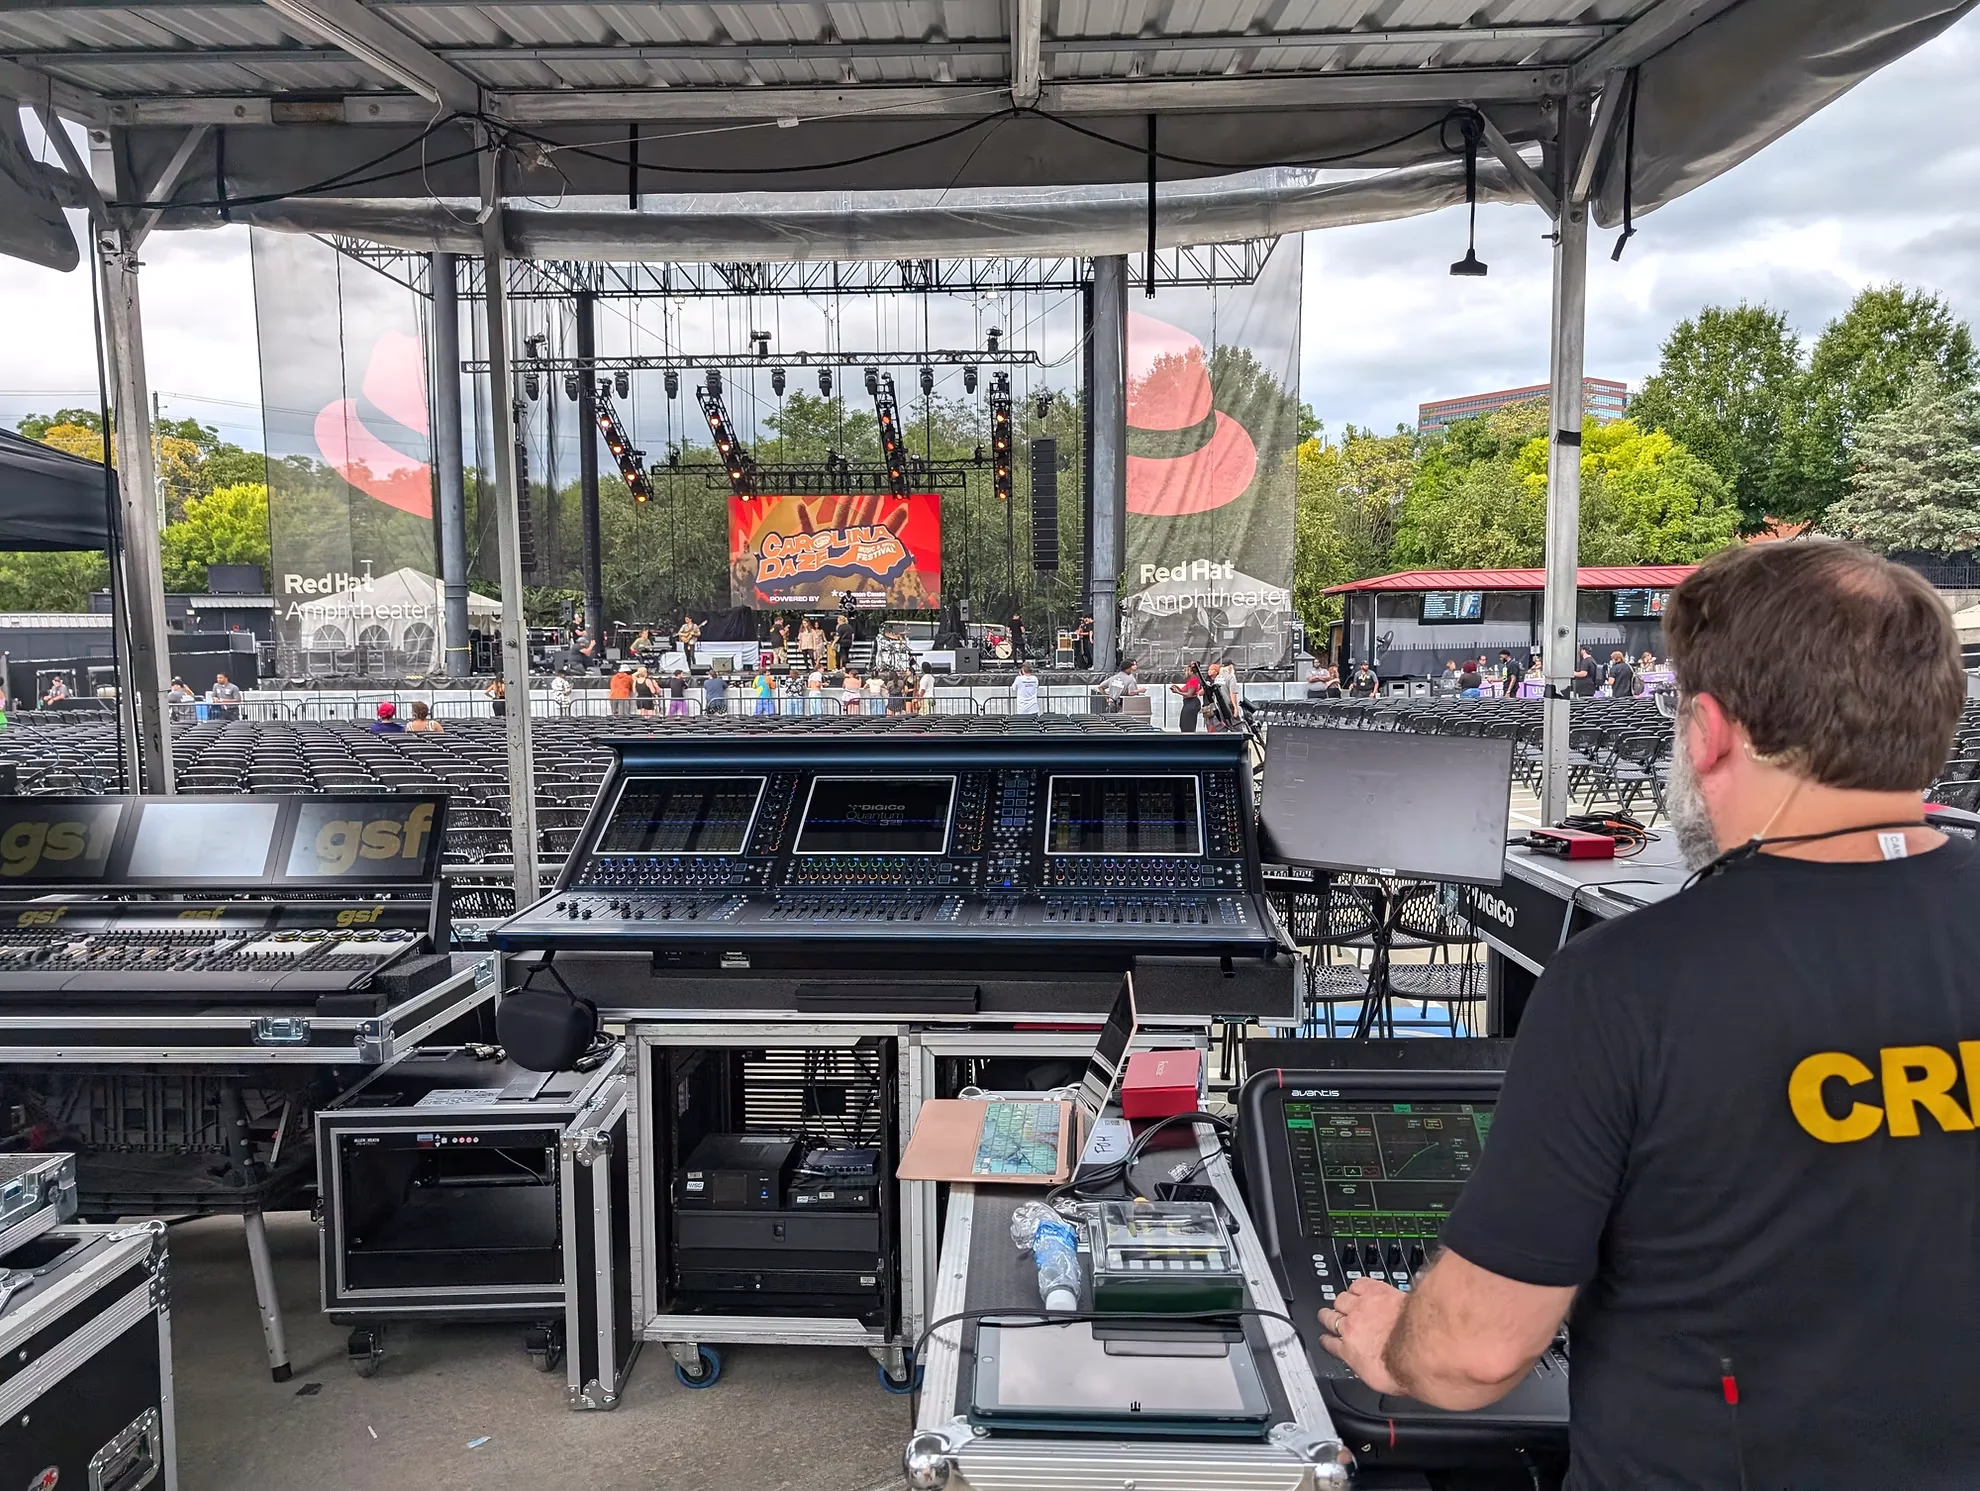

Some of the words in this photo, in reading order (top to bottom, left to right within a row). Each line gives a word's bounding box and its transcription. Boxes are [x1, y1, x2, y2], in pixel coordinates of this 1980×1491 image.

[762, 525, 896, 558] CAROLINA
[856, 547, 897, 562] FESTIVAL
[755, 549, 830, 584] DAZE
[1140, 561, 1187, 584] Red
[1191, 559, 1235, 581] Hat
[284, 573, 332, 594] Red
[335, 572, 375, 593] Hat
[285, 600, 434, 622] Amphitheater
[1138, 586, 1290, 615] Amphitheater
[846, 810, 904, 820] Quantum
[315, 803, 435, 875] gsf
[17, 905, 69, 928] gsf
[336, 904, 386, 928] gsf
[1291, 1089, 1340, 1097] avantis
